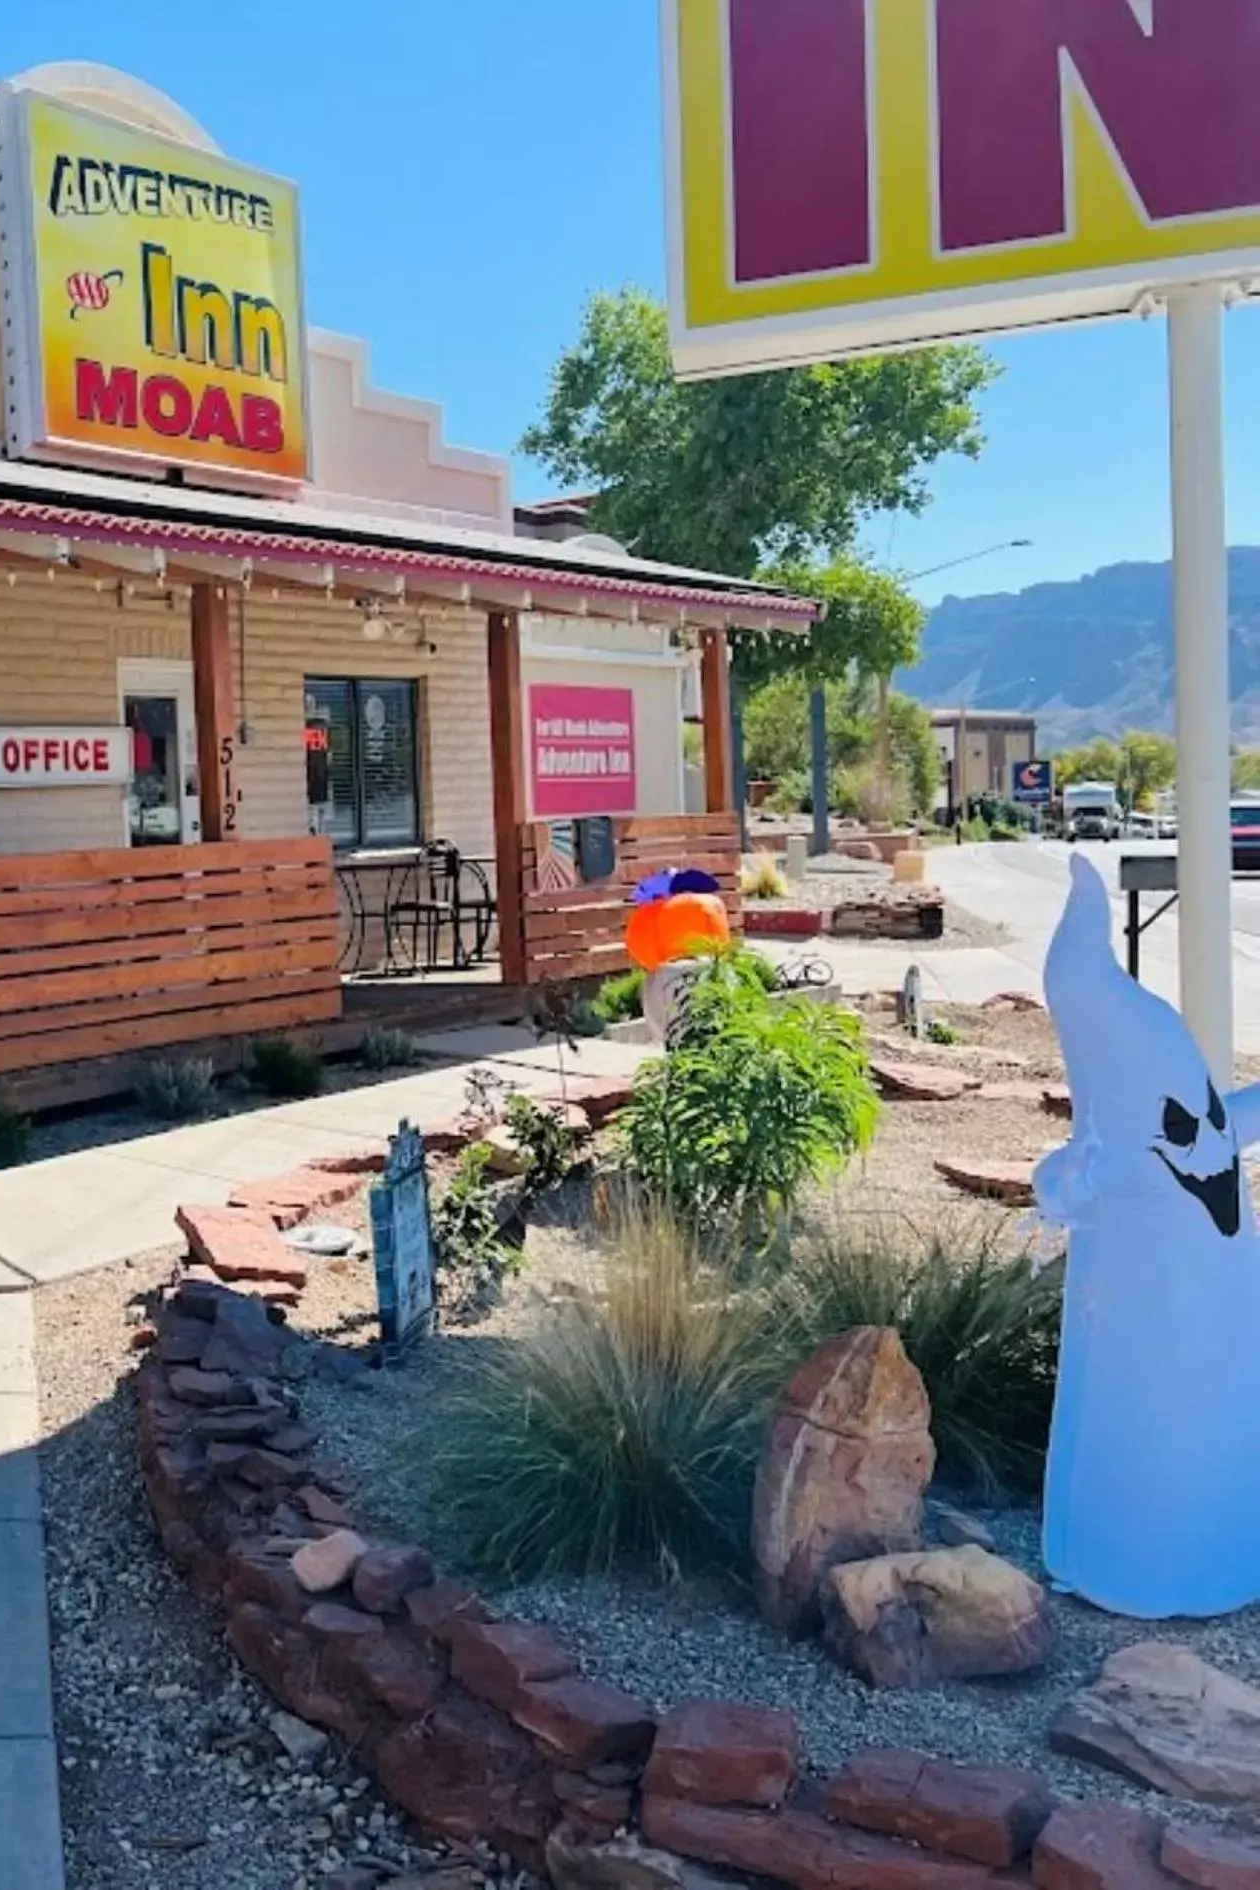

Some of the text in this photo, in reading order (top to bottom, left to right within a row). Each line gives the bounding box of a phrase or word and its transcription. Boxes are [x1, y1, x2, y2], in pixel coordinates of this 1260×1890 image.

[49, 154, 275, 233] ADVENTURE
[141, 242, 287, 382] Inn
[75, 358, 285, 453] MOAB
[2, 738, 109, 773] OFFICE
